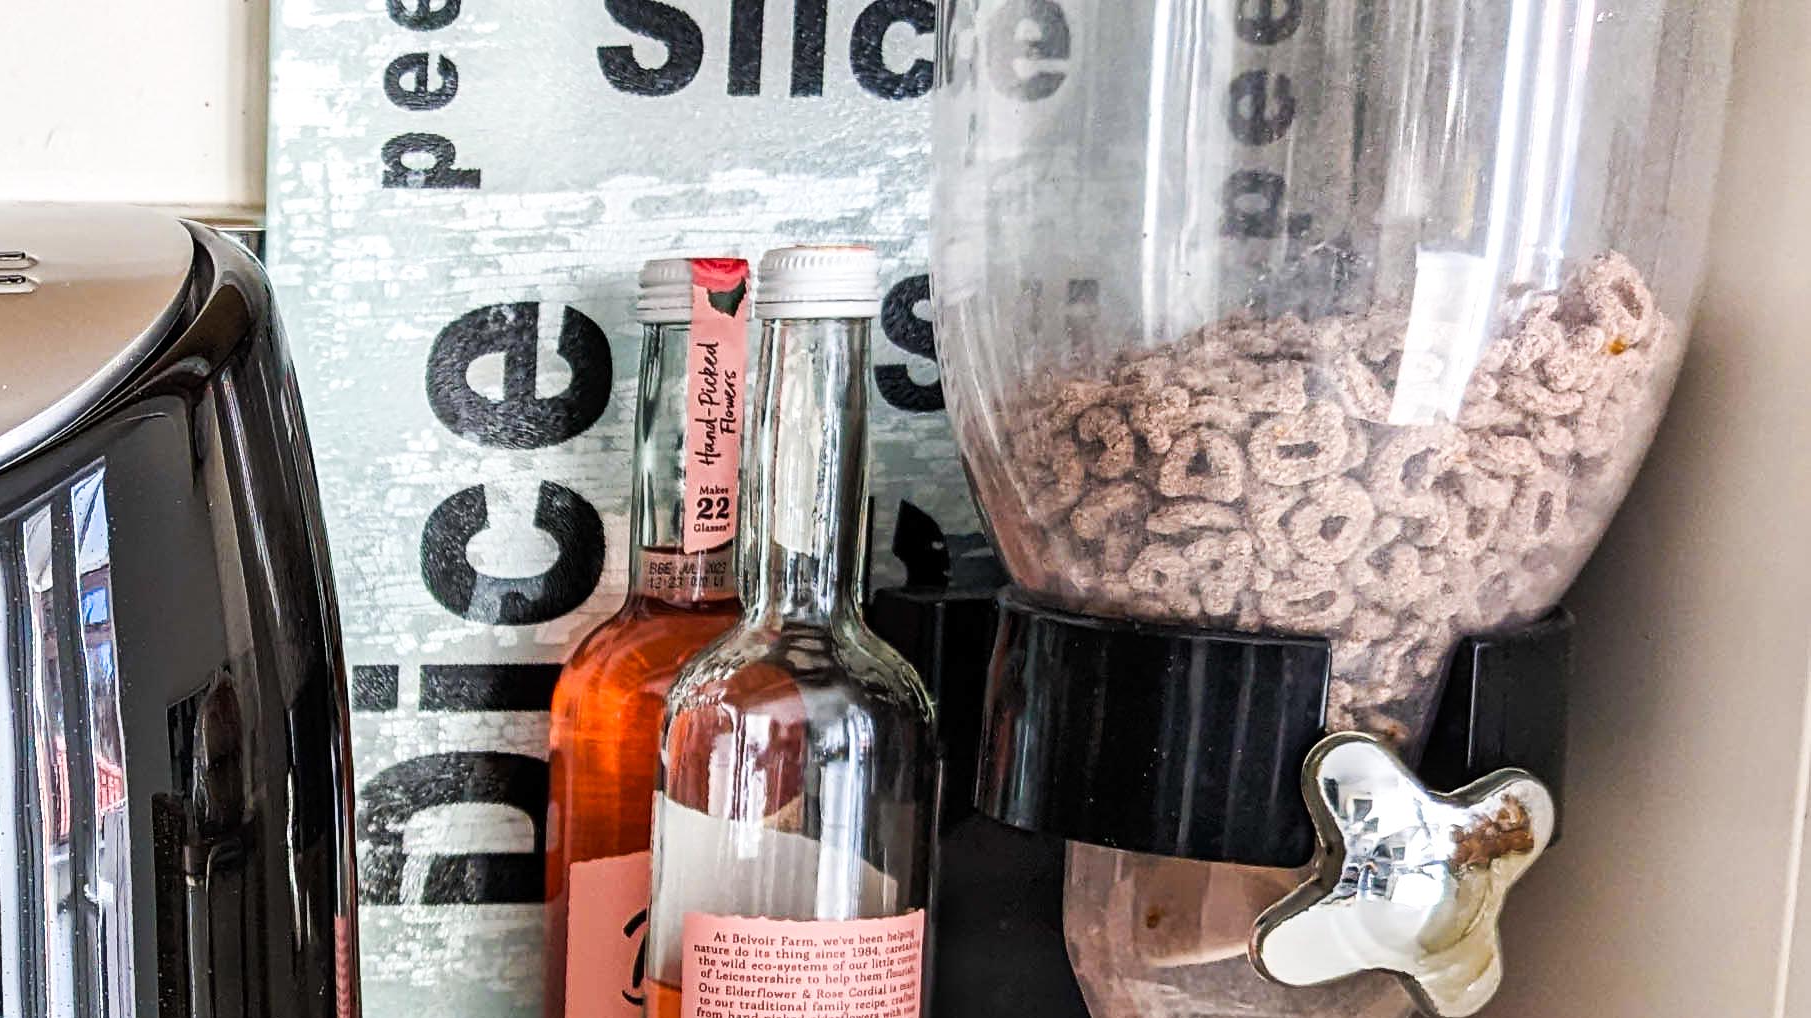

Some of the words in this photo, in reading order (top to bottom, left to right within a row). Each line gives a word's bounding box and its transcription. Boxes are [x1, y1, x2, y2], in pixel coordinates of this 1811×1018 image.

[695, 341, 721, 466] Hand-Picked
[719, 369, 736, 434] Flowers
[699, 485, 729, 495] Makes
[696, 496, 729, 520] 22
[352, 301, 612, 905] Dice
[714, 932, 727, 942] At
[733, 933, 775, 945] Belvoir
[781, 936, 817, 947] Farm,
[823, 936, 853, 946] we've
[859, 934, 883, 944] been
[694, 944, 729, 955] nature
[735, 946, 749, 957] do
[755, 948, 770, 958] its
[776, 949, 809, 961] thing
[816, 950, 845, 958] since
[699, 955, 716, 966] the
[721, 959, 746, 968] wild
[752, 962, 828, 972] eco-systems
[833, 961, 846, 971] of
[849, 961, 867, 970] our
[872, 958, 894, 969] little
[700, 968, 713, 978] of
[716, 969, 802, 984] Leicestershire
[808, 975, 819, 984] to
[825, 973, 850, 985] help
[854, 972, 882, 982] them
[698, 982, 720, 994] Our
[725, 986, 797, 999] Elderflower
[802, 989, 811, 999] &
[817, 989, 844, 999] Rose
[849, 984, 887, 998] Cordial
[697, 1007, 723, 1018] from
[699, 997, 710, 1005] to
[715, 999, 734, 1009] our
[739, 1000, 807, 1012] traditional
[812, 1001, 850, 1013] family
